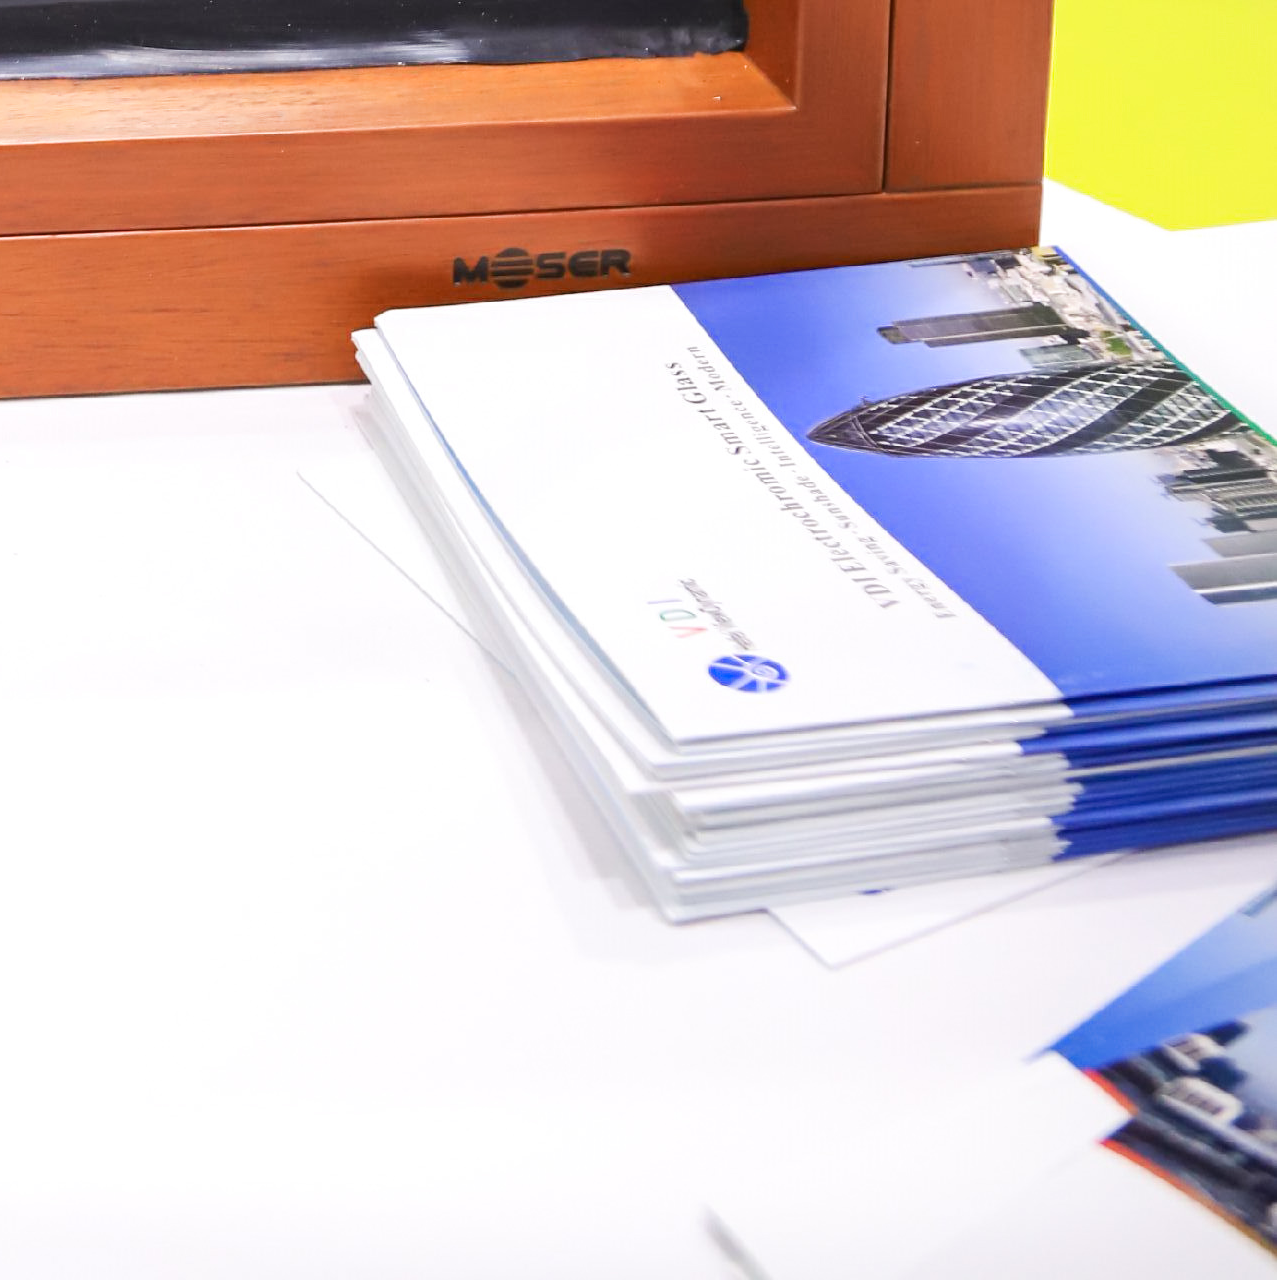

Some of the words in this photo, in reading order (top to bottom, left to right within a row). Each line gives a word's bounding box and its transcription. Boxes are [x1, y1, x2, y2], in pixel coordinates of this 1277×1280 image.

[452, 247, 632, 289] MOSER
[665, 361, 708, 404] Glass
[686, 345, 729, 392] Modern
[698, 408, 751, 456] Smart
[730, 399, 796, 468] Intelligence
[743, 457, 867, 573] Electrochromic
[796, 474, 857, 530] Sunshade
[857, 536, 909, 575] Saving
[851, 577, 901, 609] VDI
